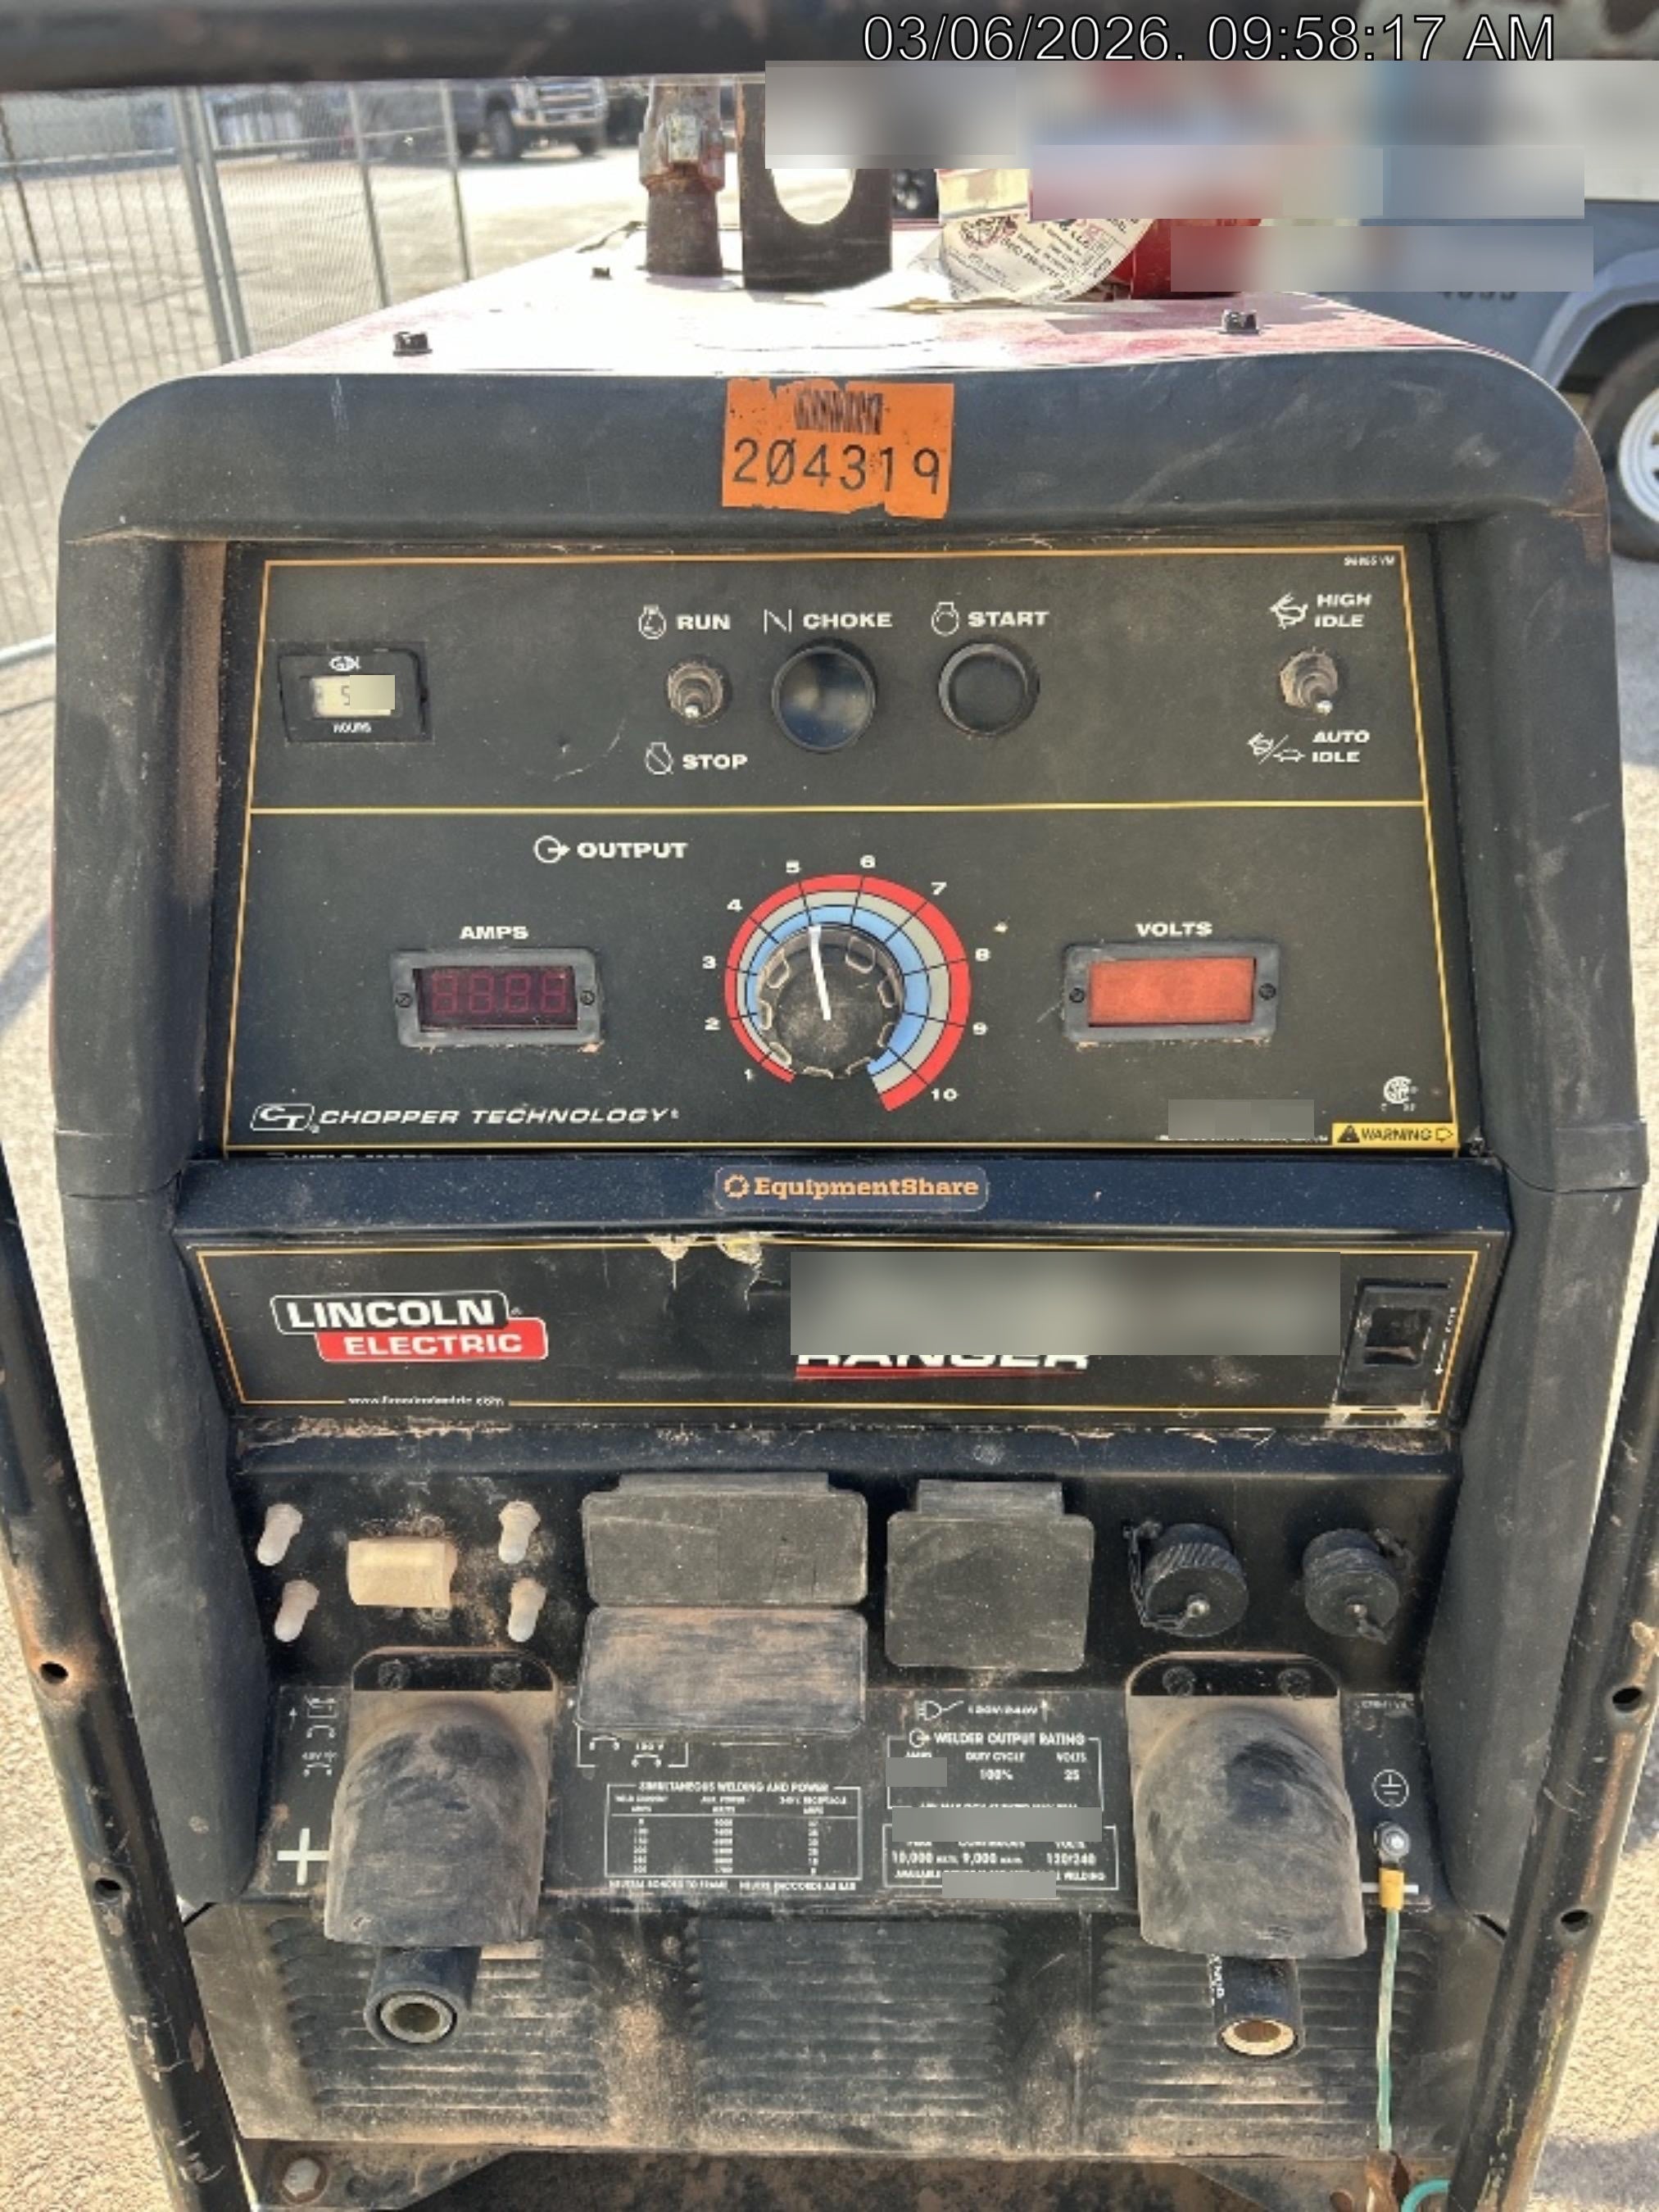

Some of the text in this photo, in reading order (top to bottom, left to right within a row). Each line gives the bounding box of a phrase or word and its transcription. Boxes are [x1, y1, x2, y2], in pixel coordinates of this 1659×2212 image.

[732, 437, 941, 494] 204319
[1317, 594, 1372, 607] HIGH
[676, 614, 731, 630] RUN
[802, 612, 893, 629] CHOKE
[967, 610, 1049, 627] START
[1314, 614, 1365, 628] IDLE
[1312, 730, 1370, 743] AUTO
[682, 754, 747, 770] STOP
[1312, 751, 1361, 763] IDLE
[577, 842, 689, 859] OUTPUT
[786, 859, 800, 873] 5
[859, 855, 876, 869] 6
[930, 882, 947, 895] 7
[727, 899, 743, 912] 4
[459, 926, 530, 940] AMPS
[1135, 921, 1213, 937] VOLTS
[702, 956, 717, 969] 3
[976, 949, 990, 962] 8
[705, 1018, 721, 1031] 2
[972, 1022, 988, 1036] 9
[744, 1068, 754, 1081] 1
[931, 1088, 958, 1101] 10
[319, 1110, 459, 1124] CHOPPER
[1362, 1127, 1432, 1141] WARNING
[754, 1176, 979, 1199] EquipmentShare
[287, 1299, 496, 1329] LINCOLN
[342, 1333, 524, 1356] ELECTRIC
[933, 1732, 1086, 1746] WELDER OUTPUT RATING
[993, 1752, 1026, 1762] CYCLE
[1056, 1752, 1087, 1763] VOLTS
